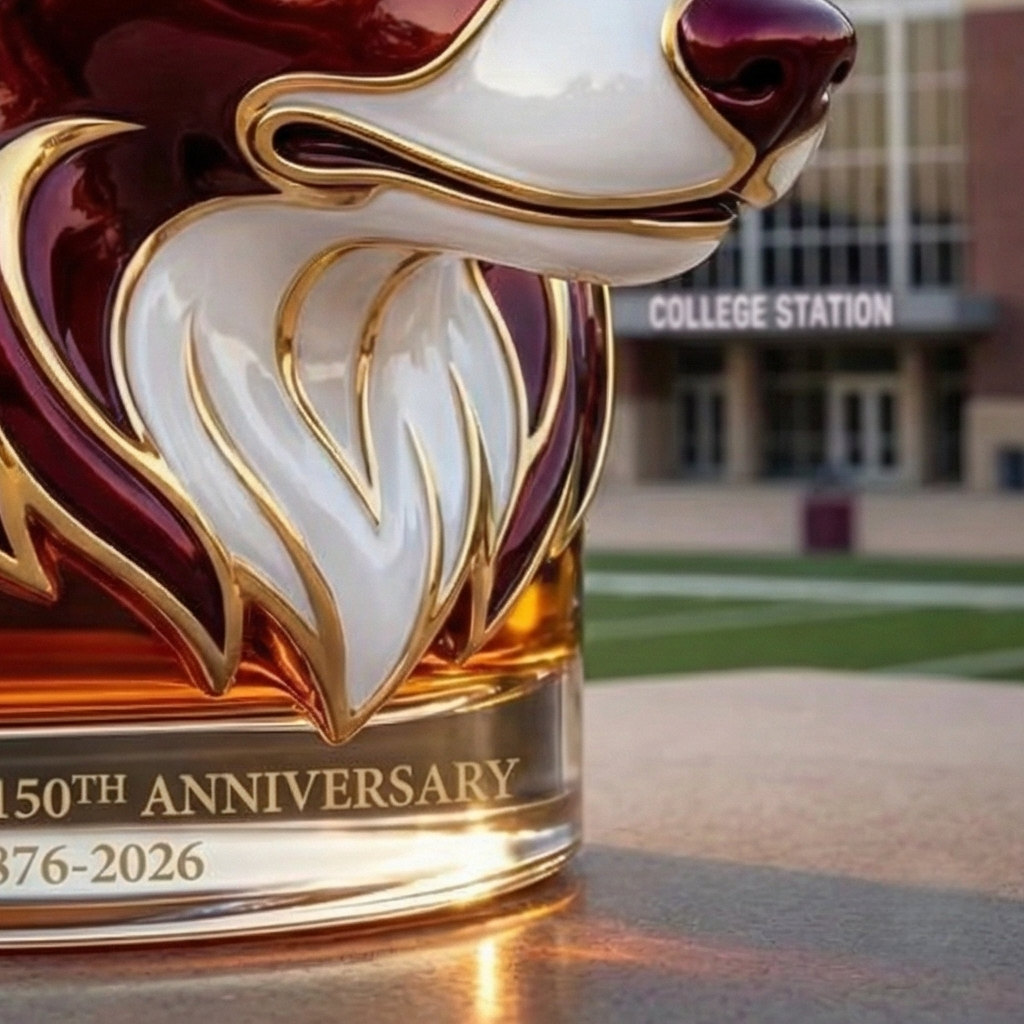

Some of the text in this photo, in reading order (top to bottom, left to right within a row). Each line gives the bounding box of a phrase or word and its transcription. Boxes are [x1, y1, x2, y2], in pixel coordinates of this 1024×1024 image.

[648, 292, 895, 331] COLLEGE STATION
[141, 757, 520, 818] ANNIVERSARY
